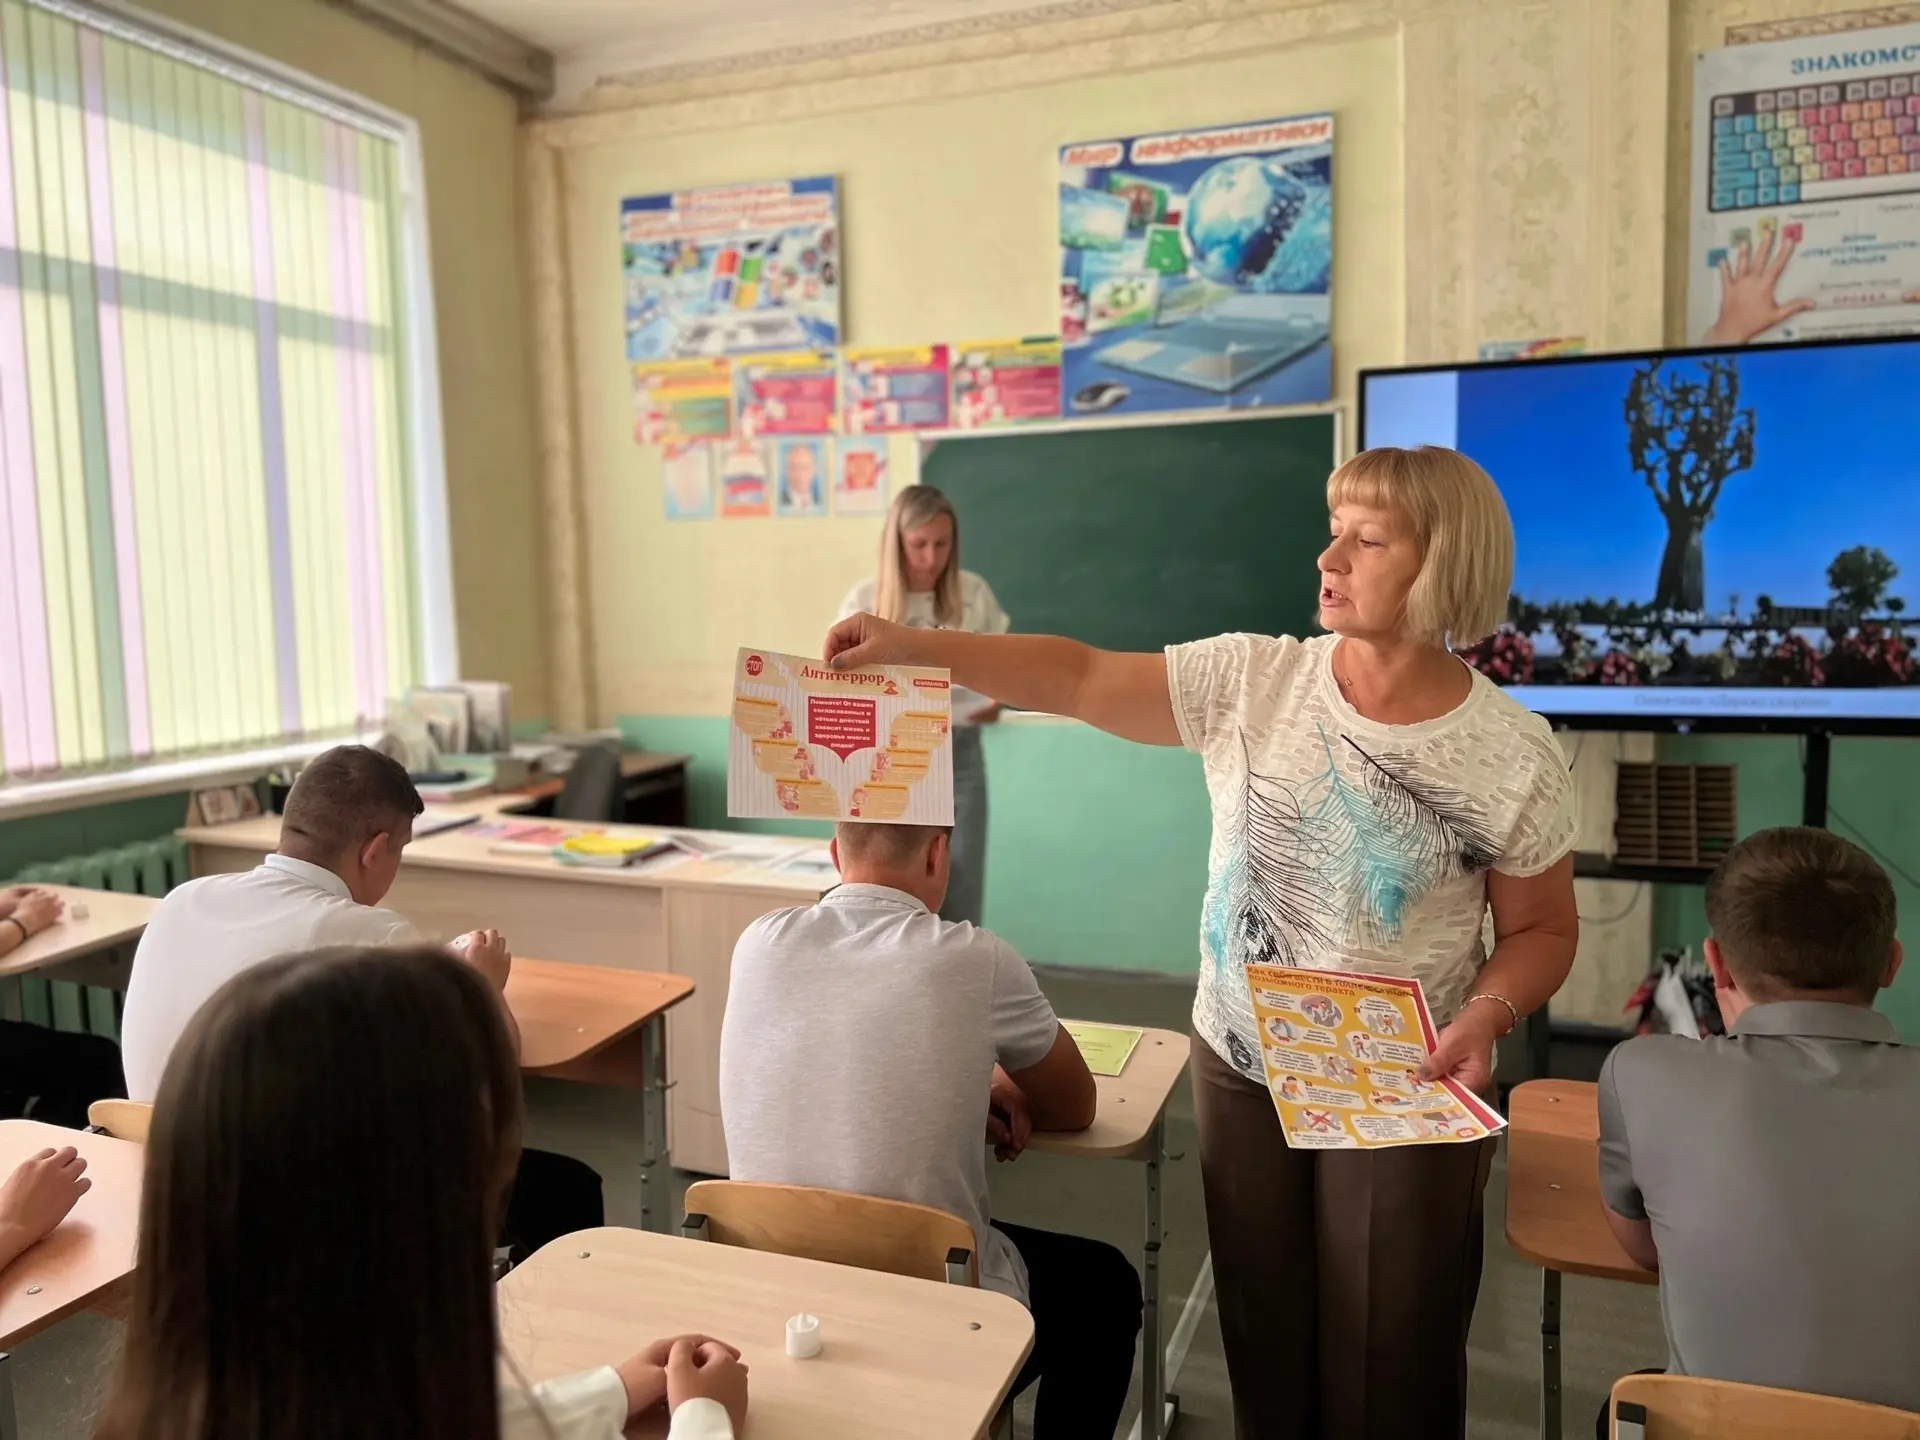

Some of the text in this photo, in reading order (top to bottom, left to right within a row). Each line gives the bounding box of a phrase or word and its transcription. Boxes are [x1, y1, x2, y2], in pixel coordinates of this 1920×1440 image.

[746, 658, 763, 672] СТОП
[800, 665, 885, 686] Антитеррор
[813, 708, 865, 716] согласованных
[1247, 966, 1266, 976] Как
[1296, 974, 1324, 984] вести
[1248, 974, 1312, 990] возможного
[1315, 984, 1355, 996] теракта
